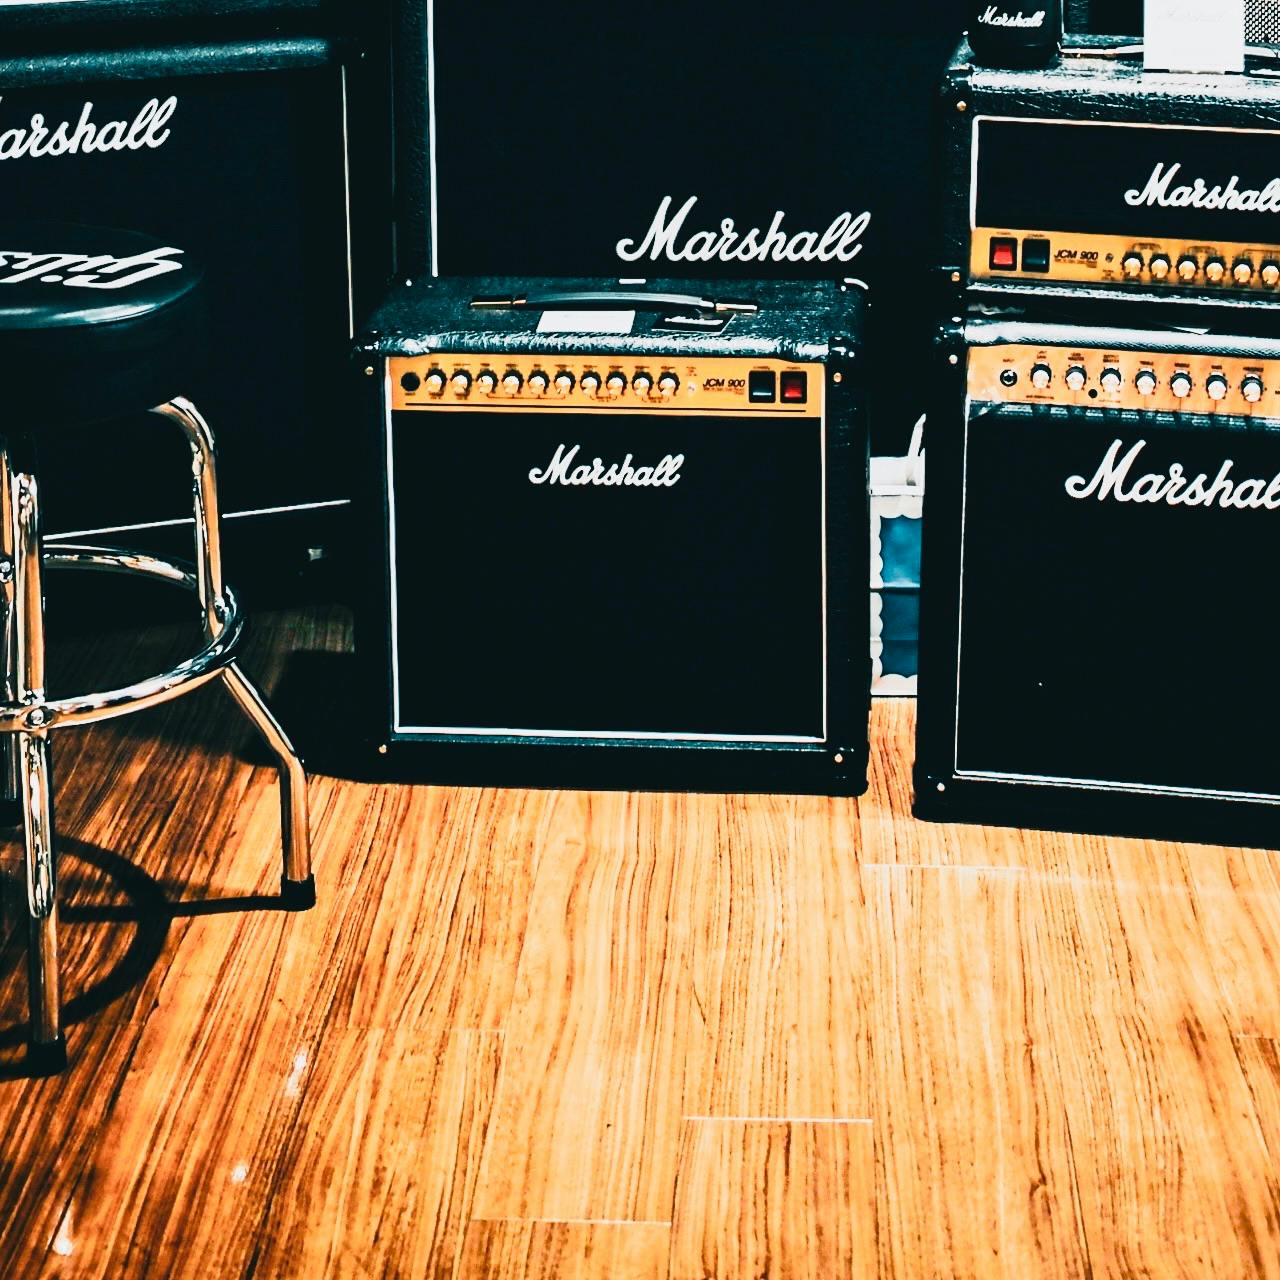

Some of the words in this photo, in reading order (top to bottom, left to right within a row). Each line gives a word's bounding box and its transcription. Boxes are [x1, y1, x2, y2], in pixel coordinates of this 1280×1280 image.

[978, 5, 1046, 28] Marshall
[616, 195, 872, 262] Marshall
[1054, 249, 1078, 259] JCM
[1079, 250, 1099, 261] 900
[702, 378, 725, 387] JCM
[727, 378, 746, 388] 900
[529, 443, 685, 487] Marshall
